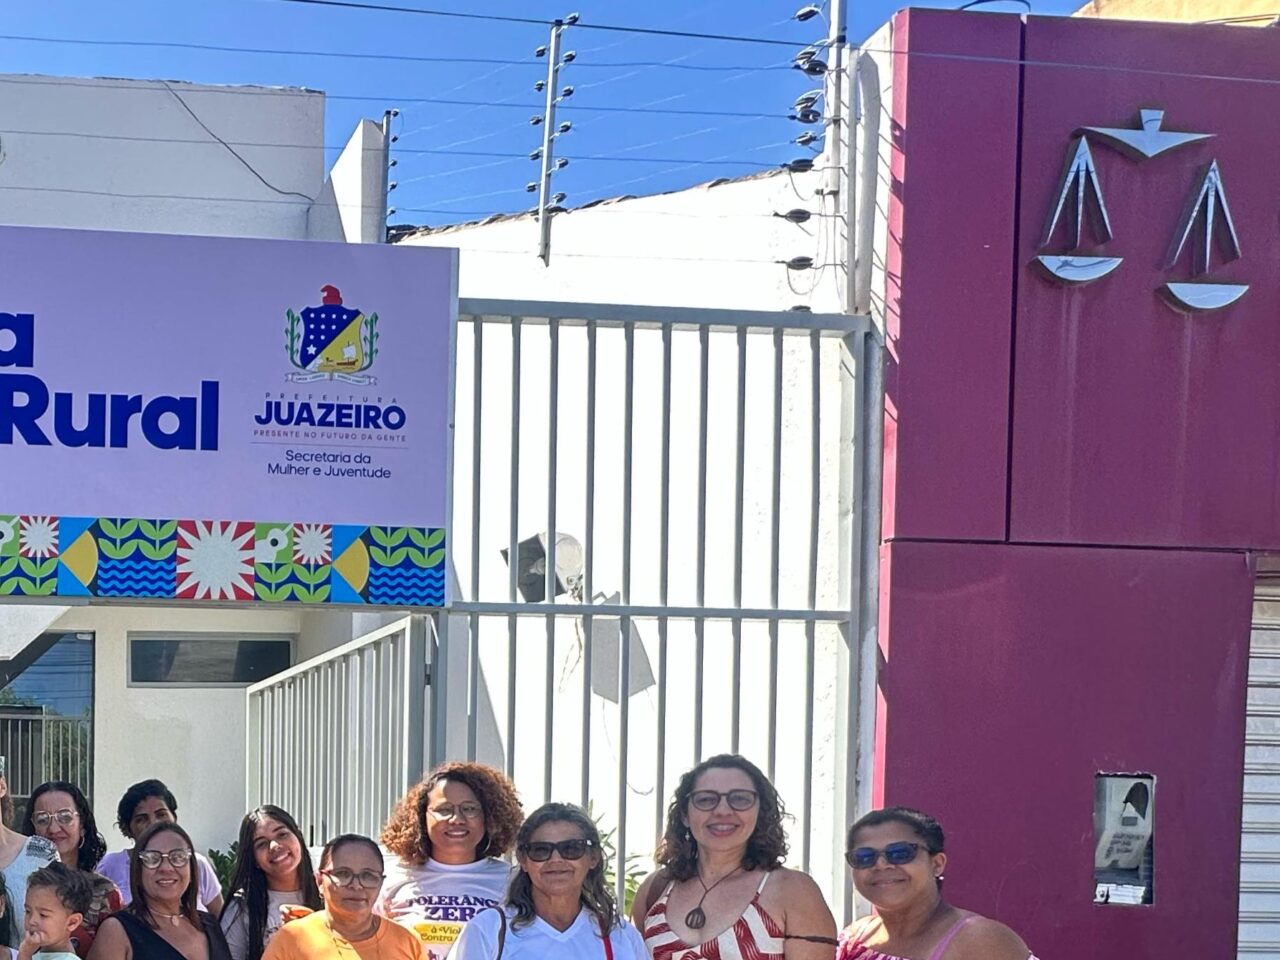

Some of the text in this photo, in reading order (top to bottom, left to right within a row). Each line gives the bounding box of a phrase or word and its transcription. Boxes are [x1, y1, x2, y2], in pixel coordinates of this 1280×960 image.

[265, 392, 397, 404] PREFEITURA
[254, 400, 407, 431] JUAZEIRO
[253, 429, 407, 442] PRESENTE NO FUTURO DA GENTE
[285, 449, 372, 464] Secretaria da
[267, 463, 392, 479] Mulher e Juventude
[405, 894, 499, 908] TOLERÂNC
[420, 932, 453, 942] Contra
